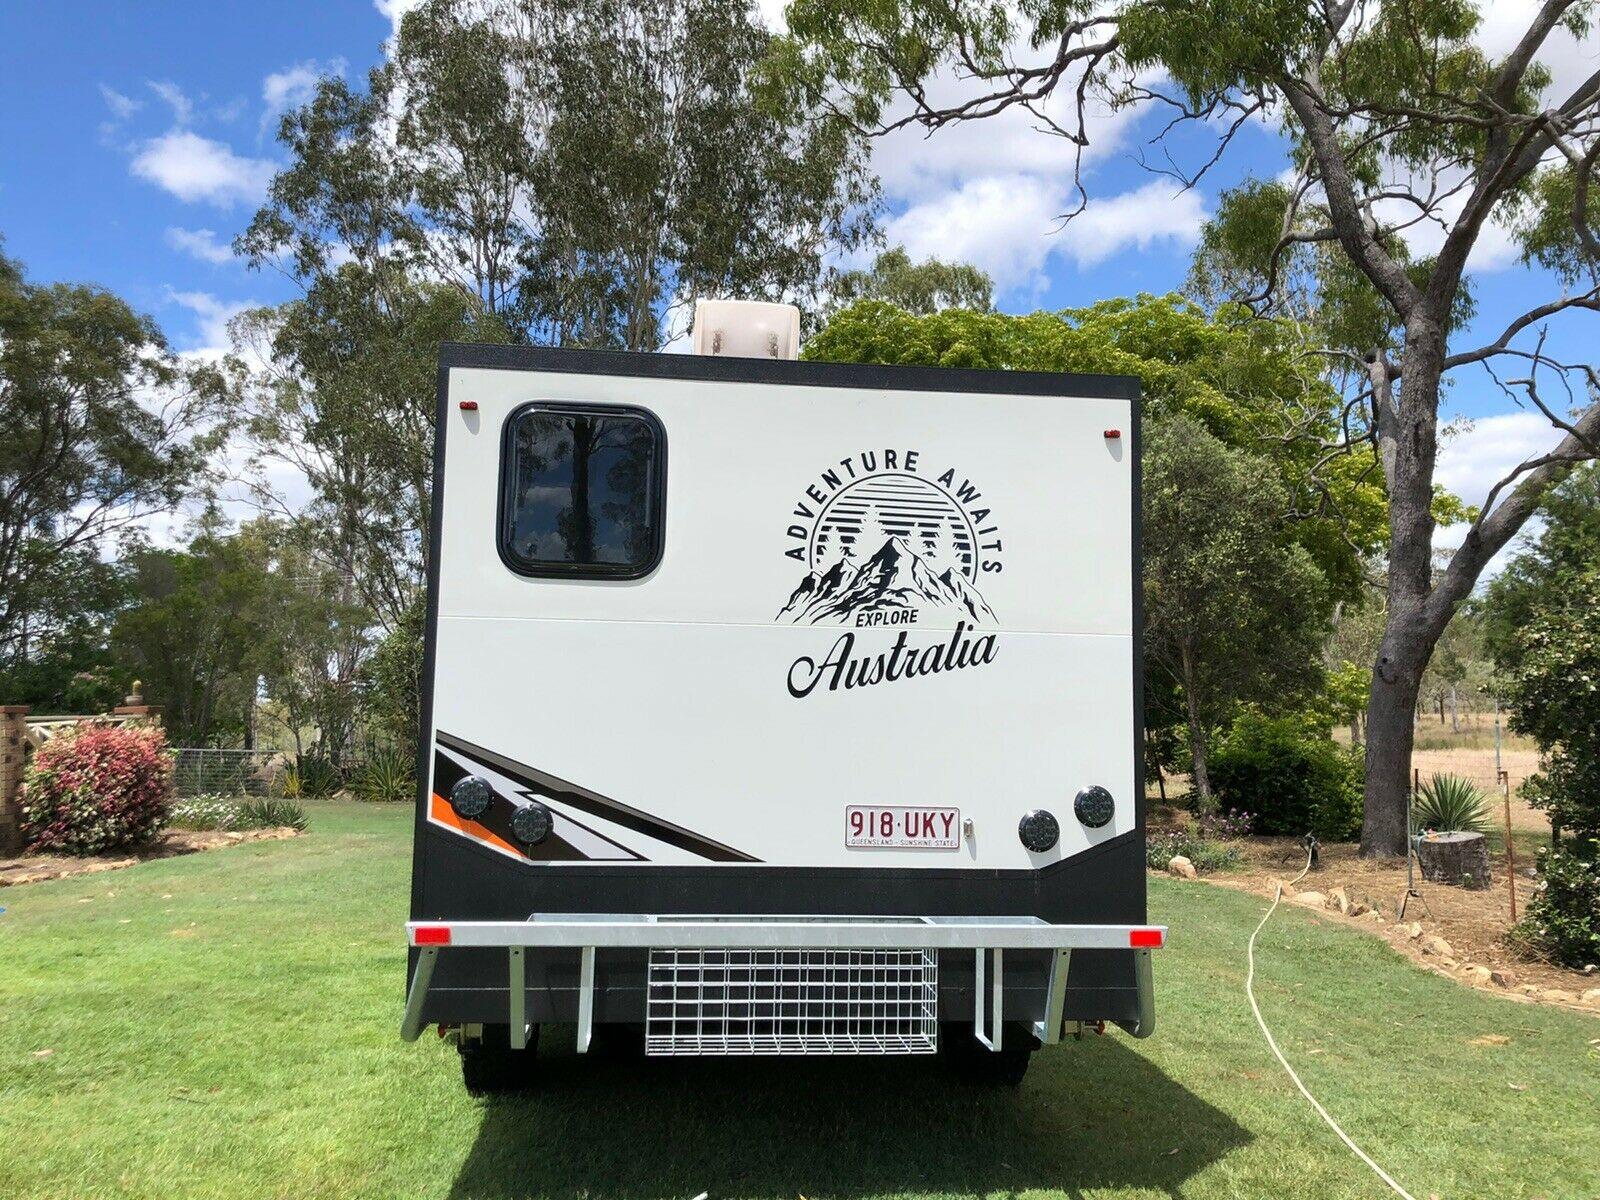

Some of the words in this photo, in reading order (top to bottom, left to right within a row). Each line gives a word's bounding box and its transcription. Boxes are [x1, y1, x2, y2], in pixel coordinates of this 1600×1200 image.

[784, 449, 920, 562] ADVENTURE
[937, 467, 1003, 573] AWAITS
[855, 608, 919, 628] EXPLORE
[786, 620, 1000, 699] Australia
